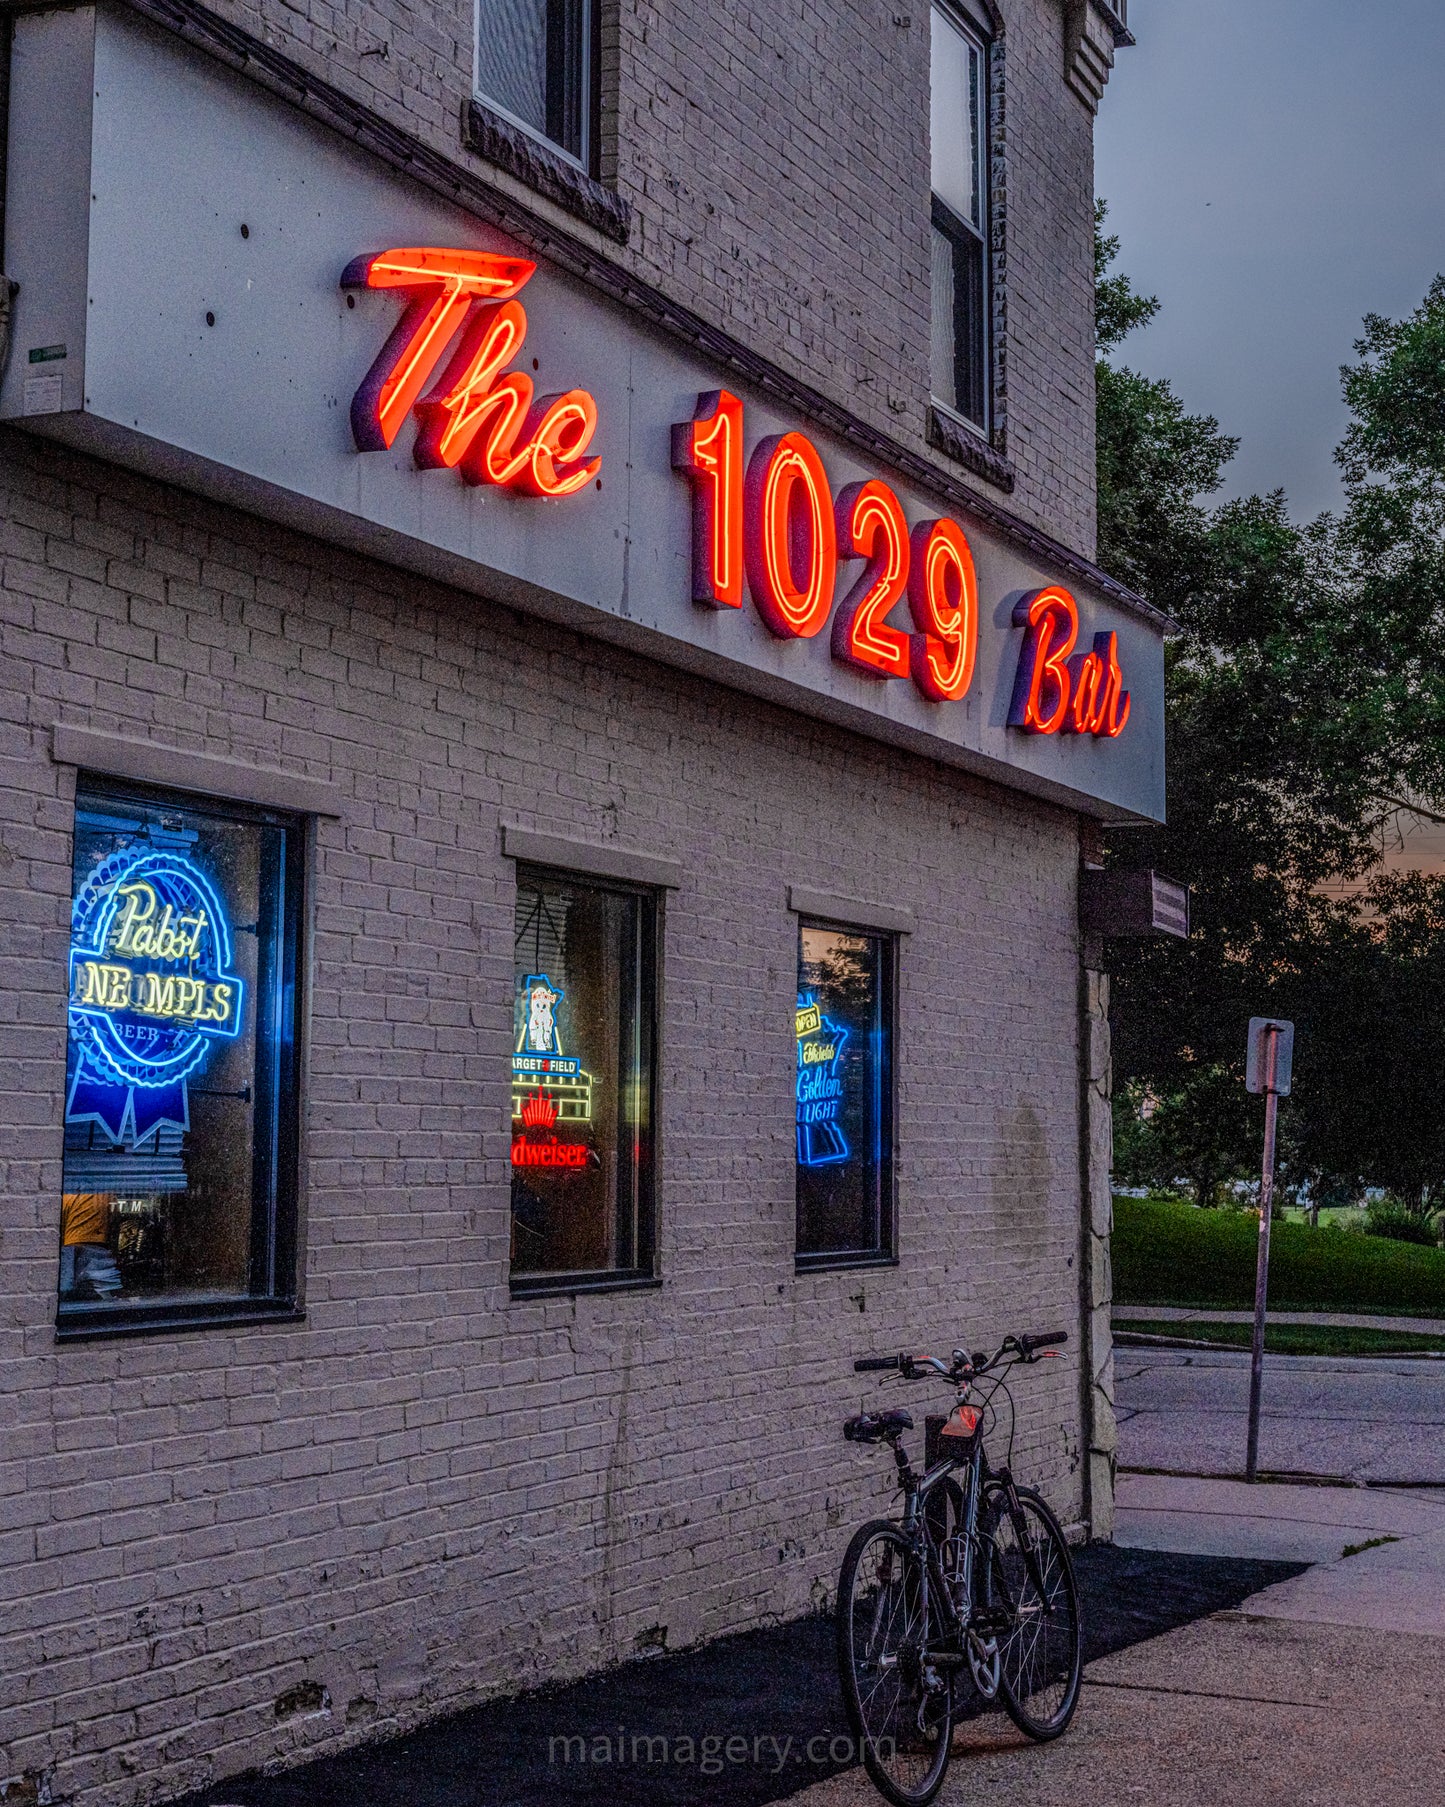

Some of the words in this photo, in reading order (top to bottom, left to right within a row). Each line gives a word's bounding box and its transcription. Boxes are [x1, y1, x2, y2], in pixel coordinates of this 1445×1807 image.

[341, 247, 603, 497] The
[671, 389, 978, 702] 1029
[1008, 586, 1131, 738] Bar
[115, 884, 209, 960] Pabst
[82, 961, 131, 1008] NE
[143, 973, 232, 1021] MPLS
[549, 1059, 576, 1073] FIELD
[796, 1066, 844, 1102] Golden
